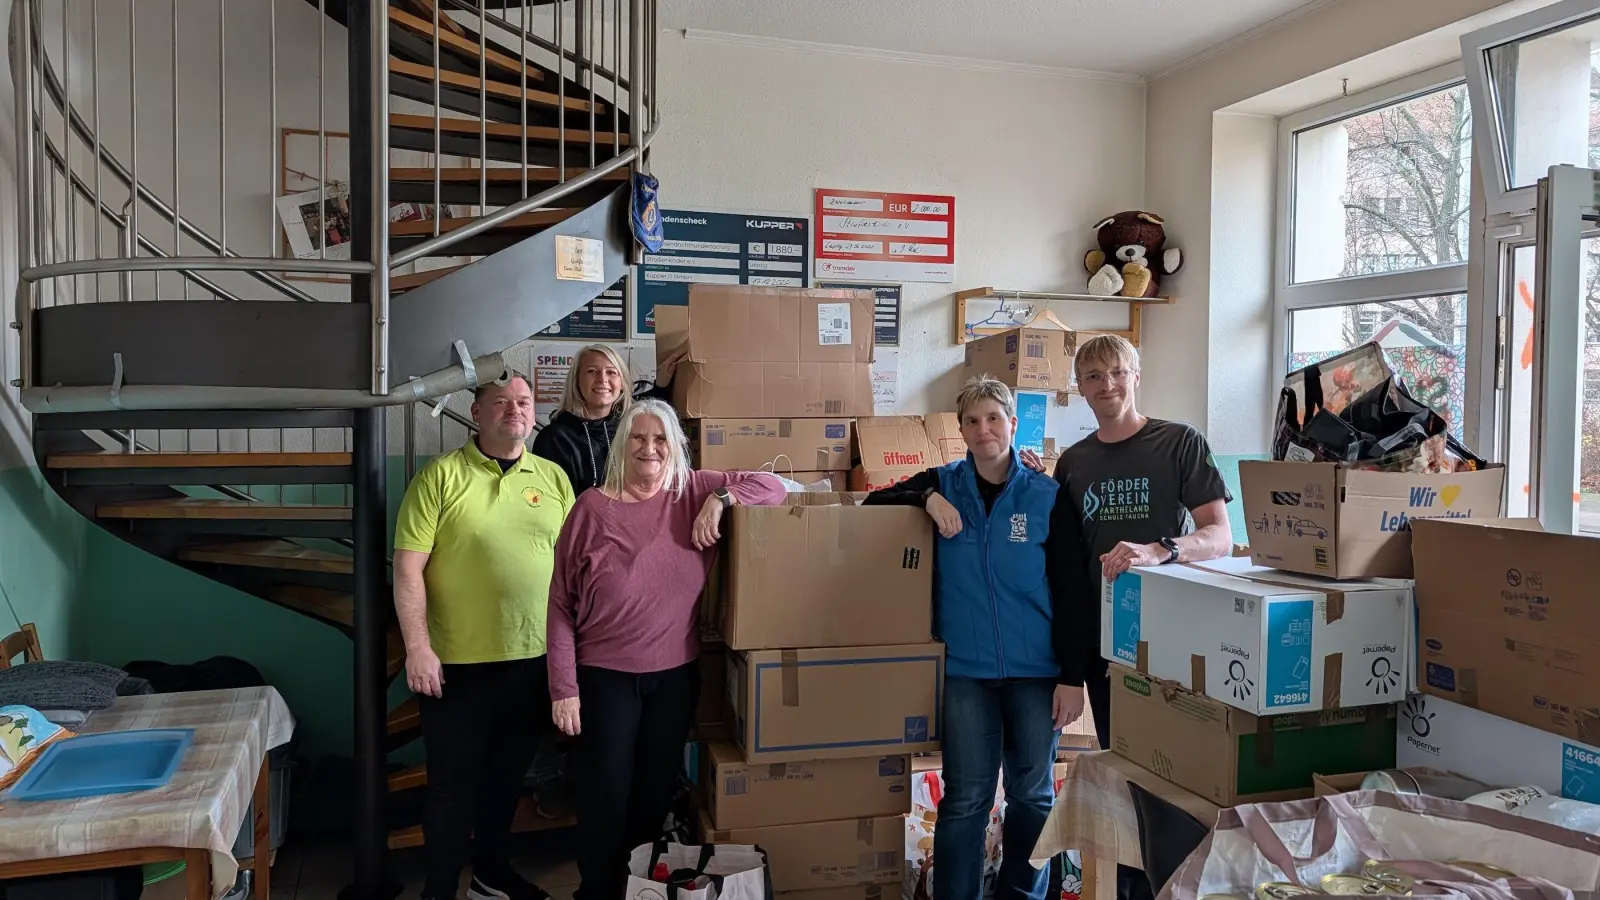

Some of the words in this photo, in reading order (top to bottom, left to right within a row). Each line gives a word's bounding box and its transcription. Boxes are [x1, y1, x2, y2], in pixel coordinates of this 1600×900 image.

[889, 203, 908, 213] EUR
[661, 215, 708, 226] ndenscheck
[746, 219, 795, 230] KUPPER
[537, 355, 574, 366] SPEND
[1101, 477, 1149, 493] FÖRDER
[1101, 491, 1149, 506] VEREIN
[1408, 486, 1437, 508] Wir
[1220, 644, 1250, 660] Papernet
[1362, 644, 1397, 654] Papernet
[1273, 691, 1308, 705] 416642
[1407, 735, 1441, 754] Papernet
[1565, 746, 1600, 768] 41664
